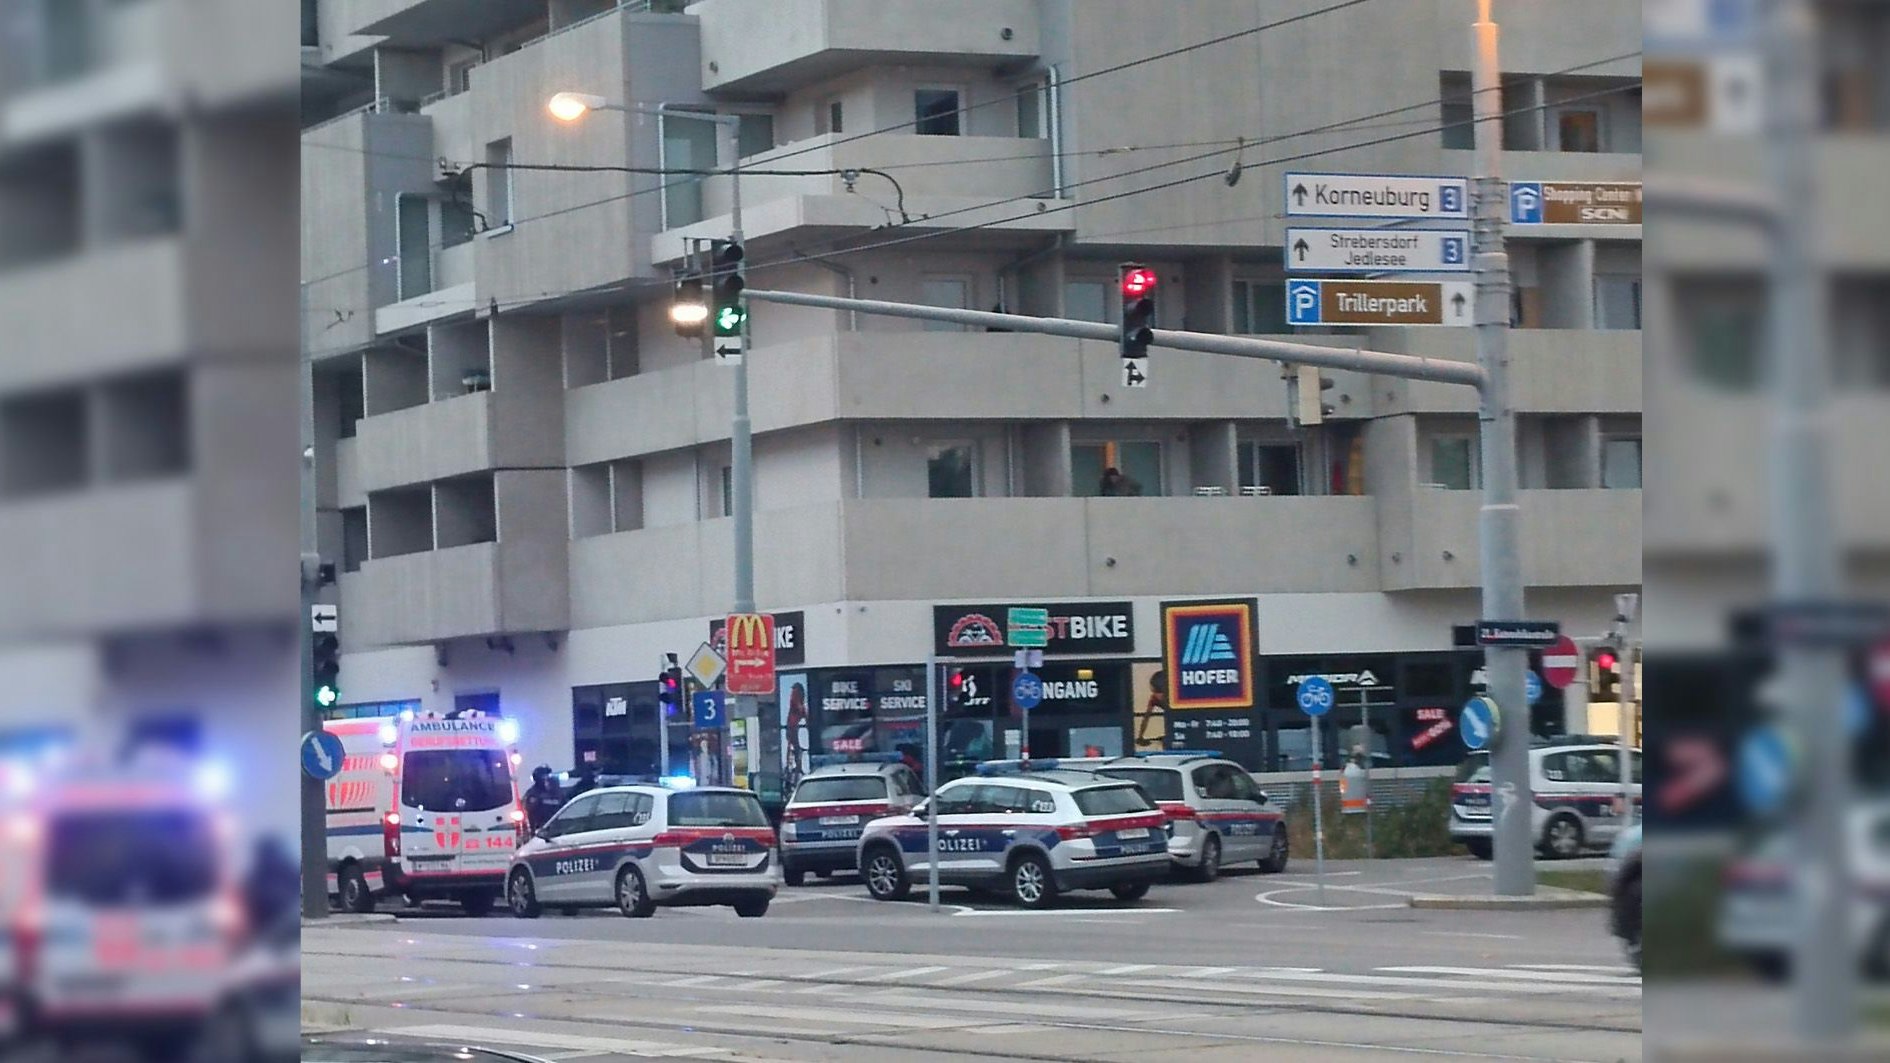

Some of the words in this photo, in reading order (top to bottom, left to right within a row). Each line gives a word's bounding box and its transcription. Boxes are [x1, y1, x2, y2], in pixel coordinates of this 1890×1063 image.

[1315, 184, 1430, 211] Korneuburg
[1444, 189, 1457, 210] 3
[1544, 186, 1592, 204] Shopping
[1582, 208, 1629, 220] SCN
[1330, 233, 1418, 249] Strebersdorf
[1445, 241, 1458, 261] 3
[1344, 251, 1406, 267] Jedlesee
[1336, 292, 1427, 317] Trillerpark
[1182, 668, 1239, 686] HOFER
[832, 681, 858, 693] BIKE
[893, 679, 912, 691] SKI
[1042, 680, 1099, 700] NGANG
[703, 698, 716, 720] 3
[822, 697, 868, 710] SERVICE
[880, 696, 926, 709] SERVICE
[1416, 708, 1445, 720] SALE
[411, 721, 495, 732] AMBULANCE
[833, 739, 863, 750] SALE
[487, 836, 513, 848] 144
[712, 844, 746, 852] POLIZEI
[938, 838, 981, 851] OLIZEI
[556, 857, 594, 875] POLIZEI
